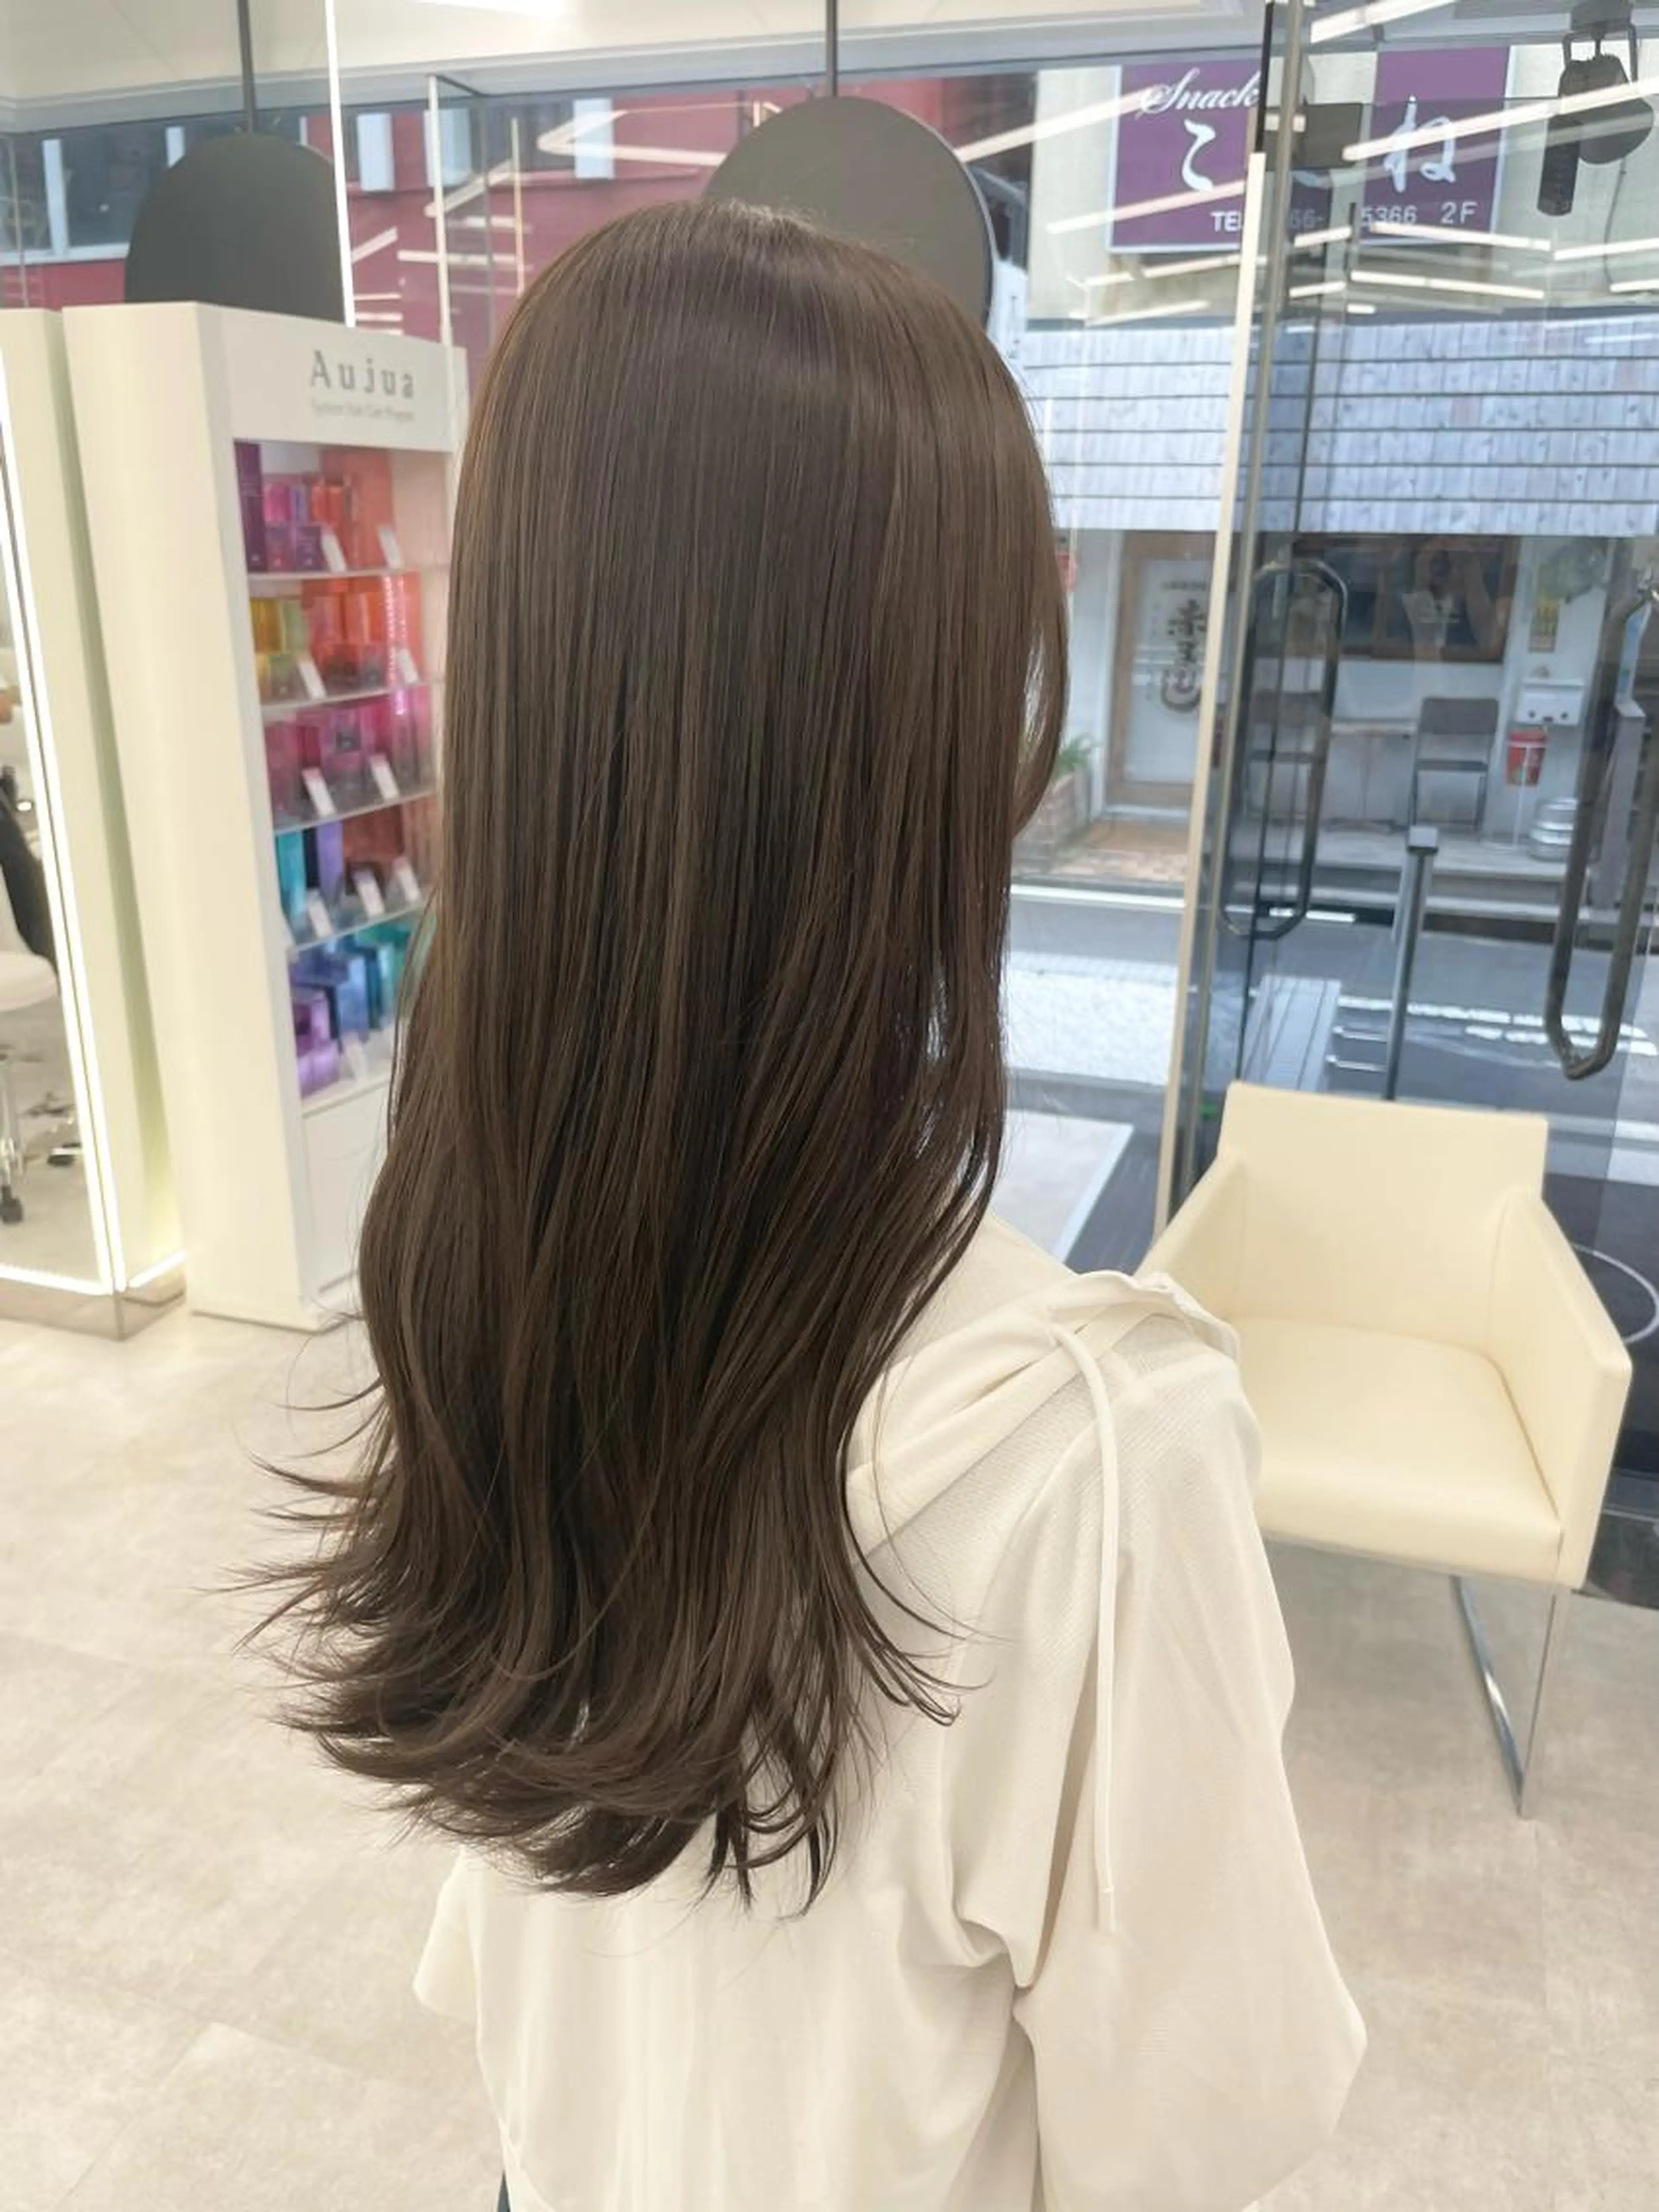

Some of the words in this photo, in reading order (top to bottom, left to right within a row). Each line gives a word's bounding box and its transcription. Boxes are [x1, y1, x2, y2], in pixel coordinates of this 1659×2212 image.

[1135, 67, 1261, 119] Snack
[1440, 201, 1478, 225] 2F
[311, 349, 414, 400] Aujua
